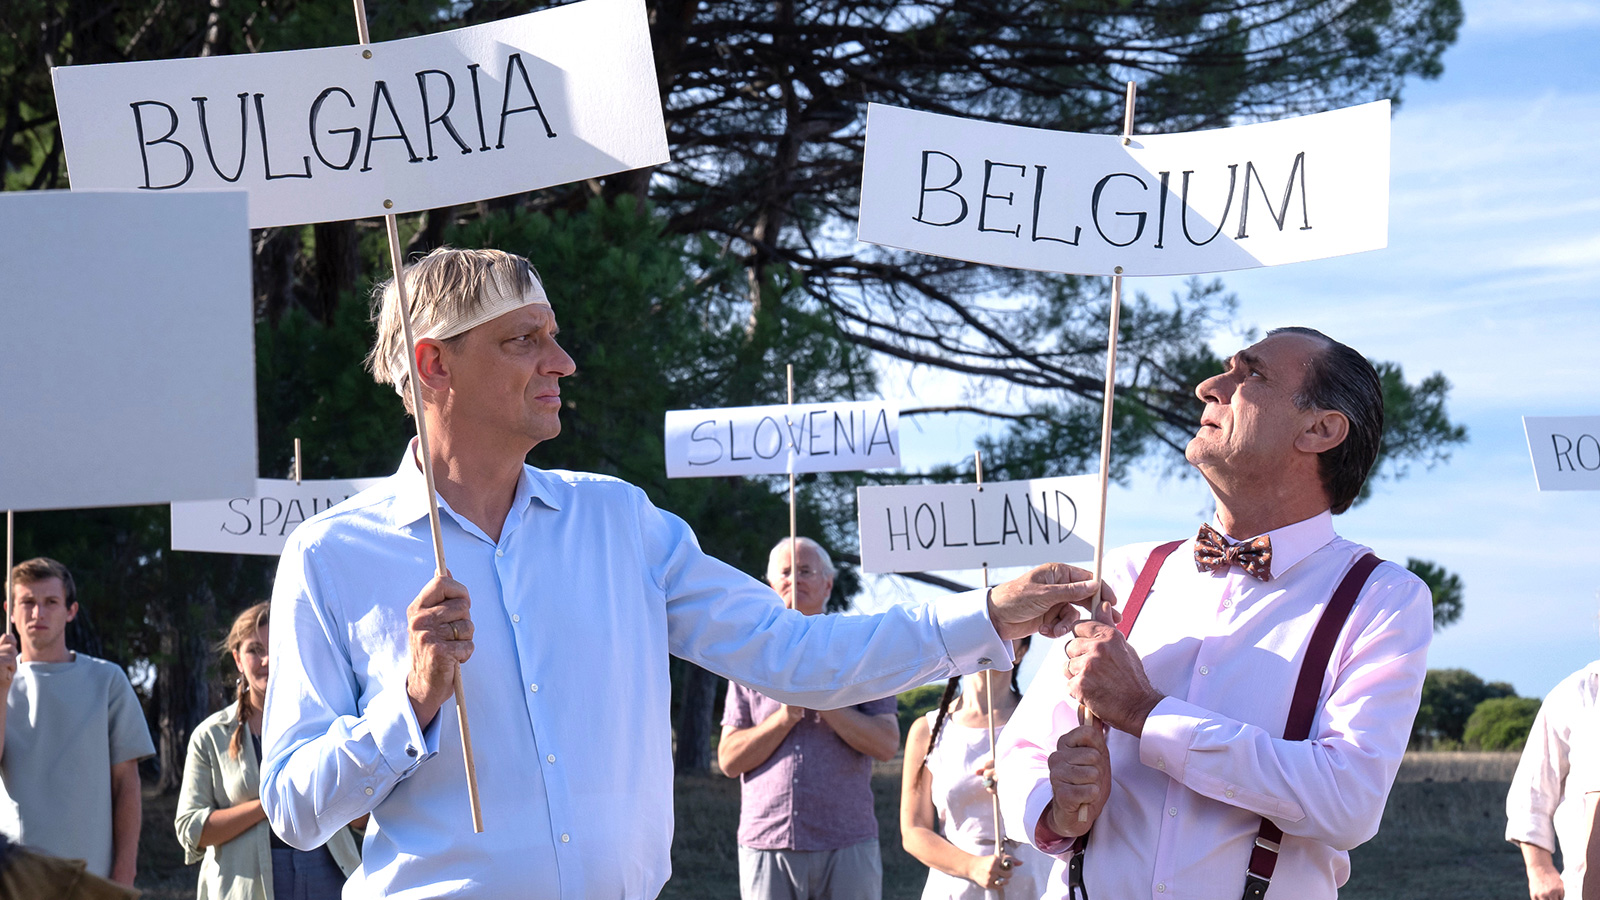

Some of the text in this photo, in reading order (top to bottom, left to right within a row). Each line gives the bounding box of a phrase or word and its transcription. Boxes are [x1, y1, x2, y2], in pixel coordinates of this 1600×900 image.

[129, 53, 557, 190] BULGARIA
[911, 150, 1312, 250] BELGIUM
[688, 408, 896, 466] SLOVENIA
[220, 495, 349, 536] SPA
[886, 489, 1078, 552] HOLLAND
